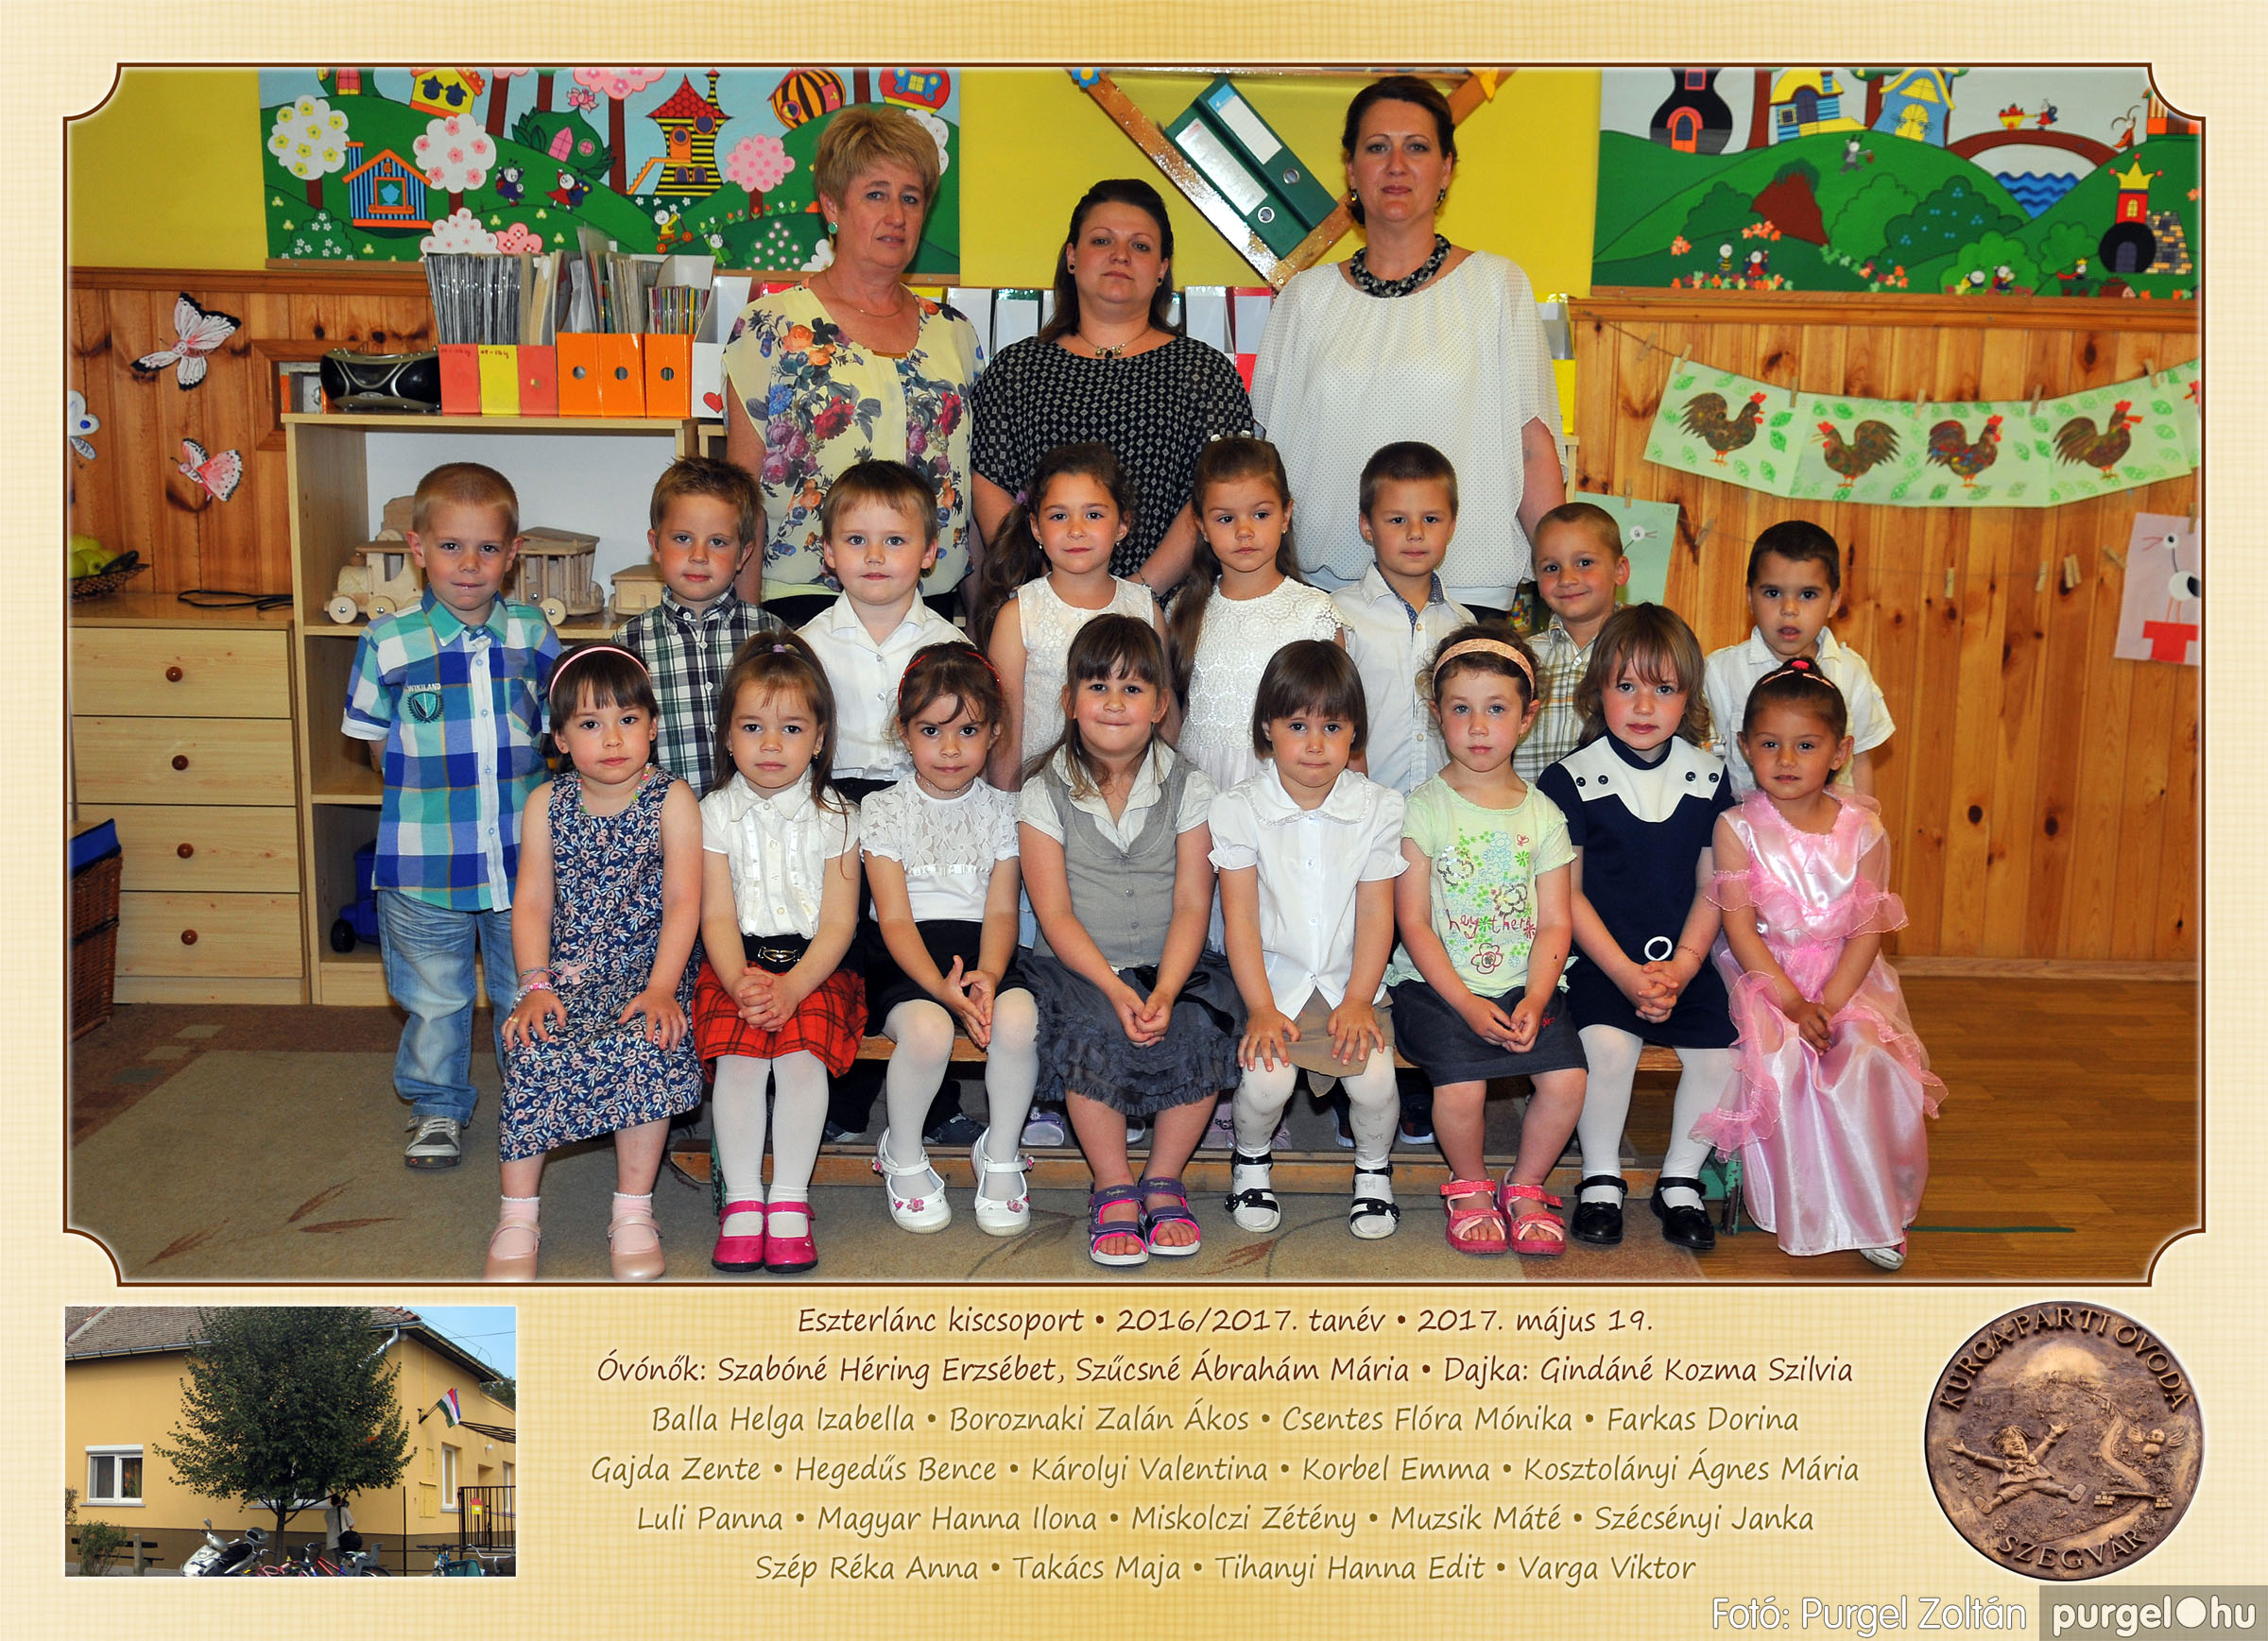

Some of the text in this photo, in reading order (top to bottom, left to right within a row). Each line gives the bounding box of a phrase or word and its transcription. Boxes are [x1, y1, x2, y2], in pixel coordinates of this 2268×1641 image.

[1445, 908, 1533, 940] hey there
[1997, 1530, 2148, 1570] SZEGVÁR
